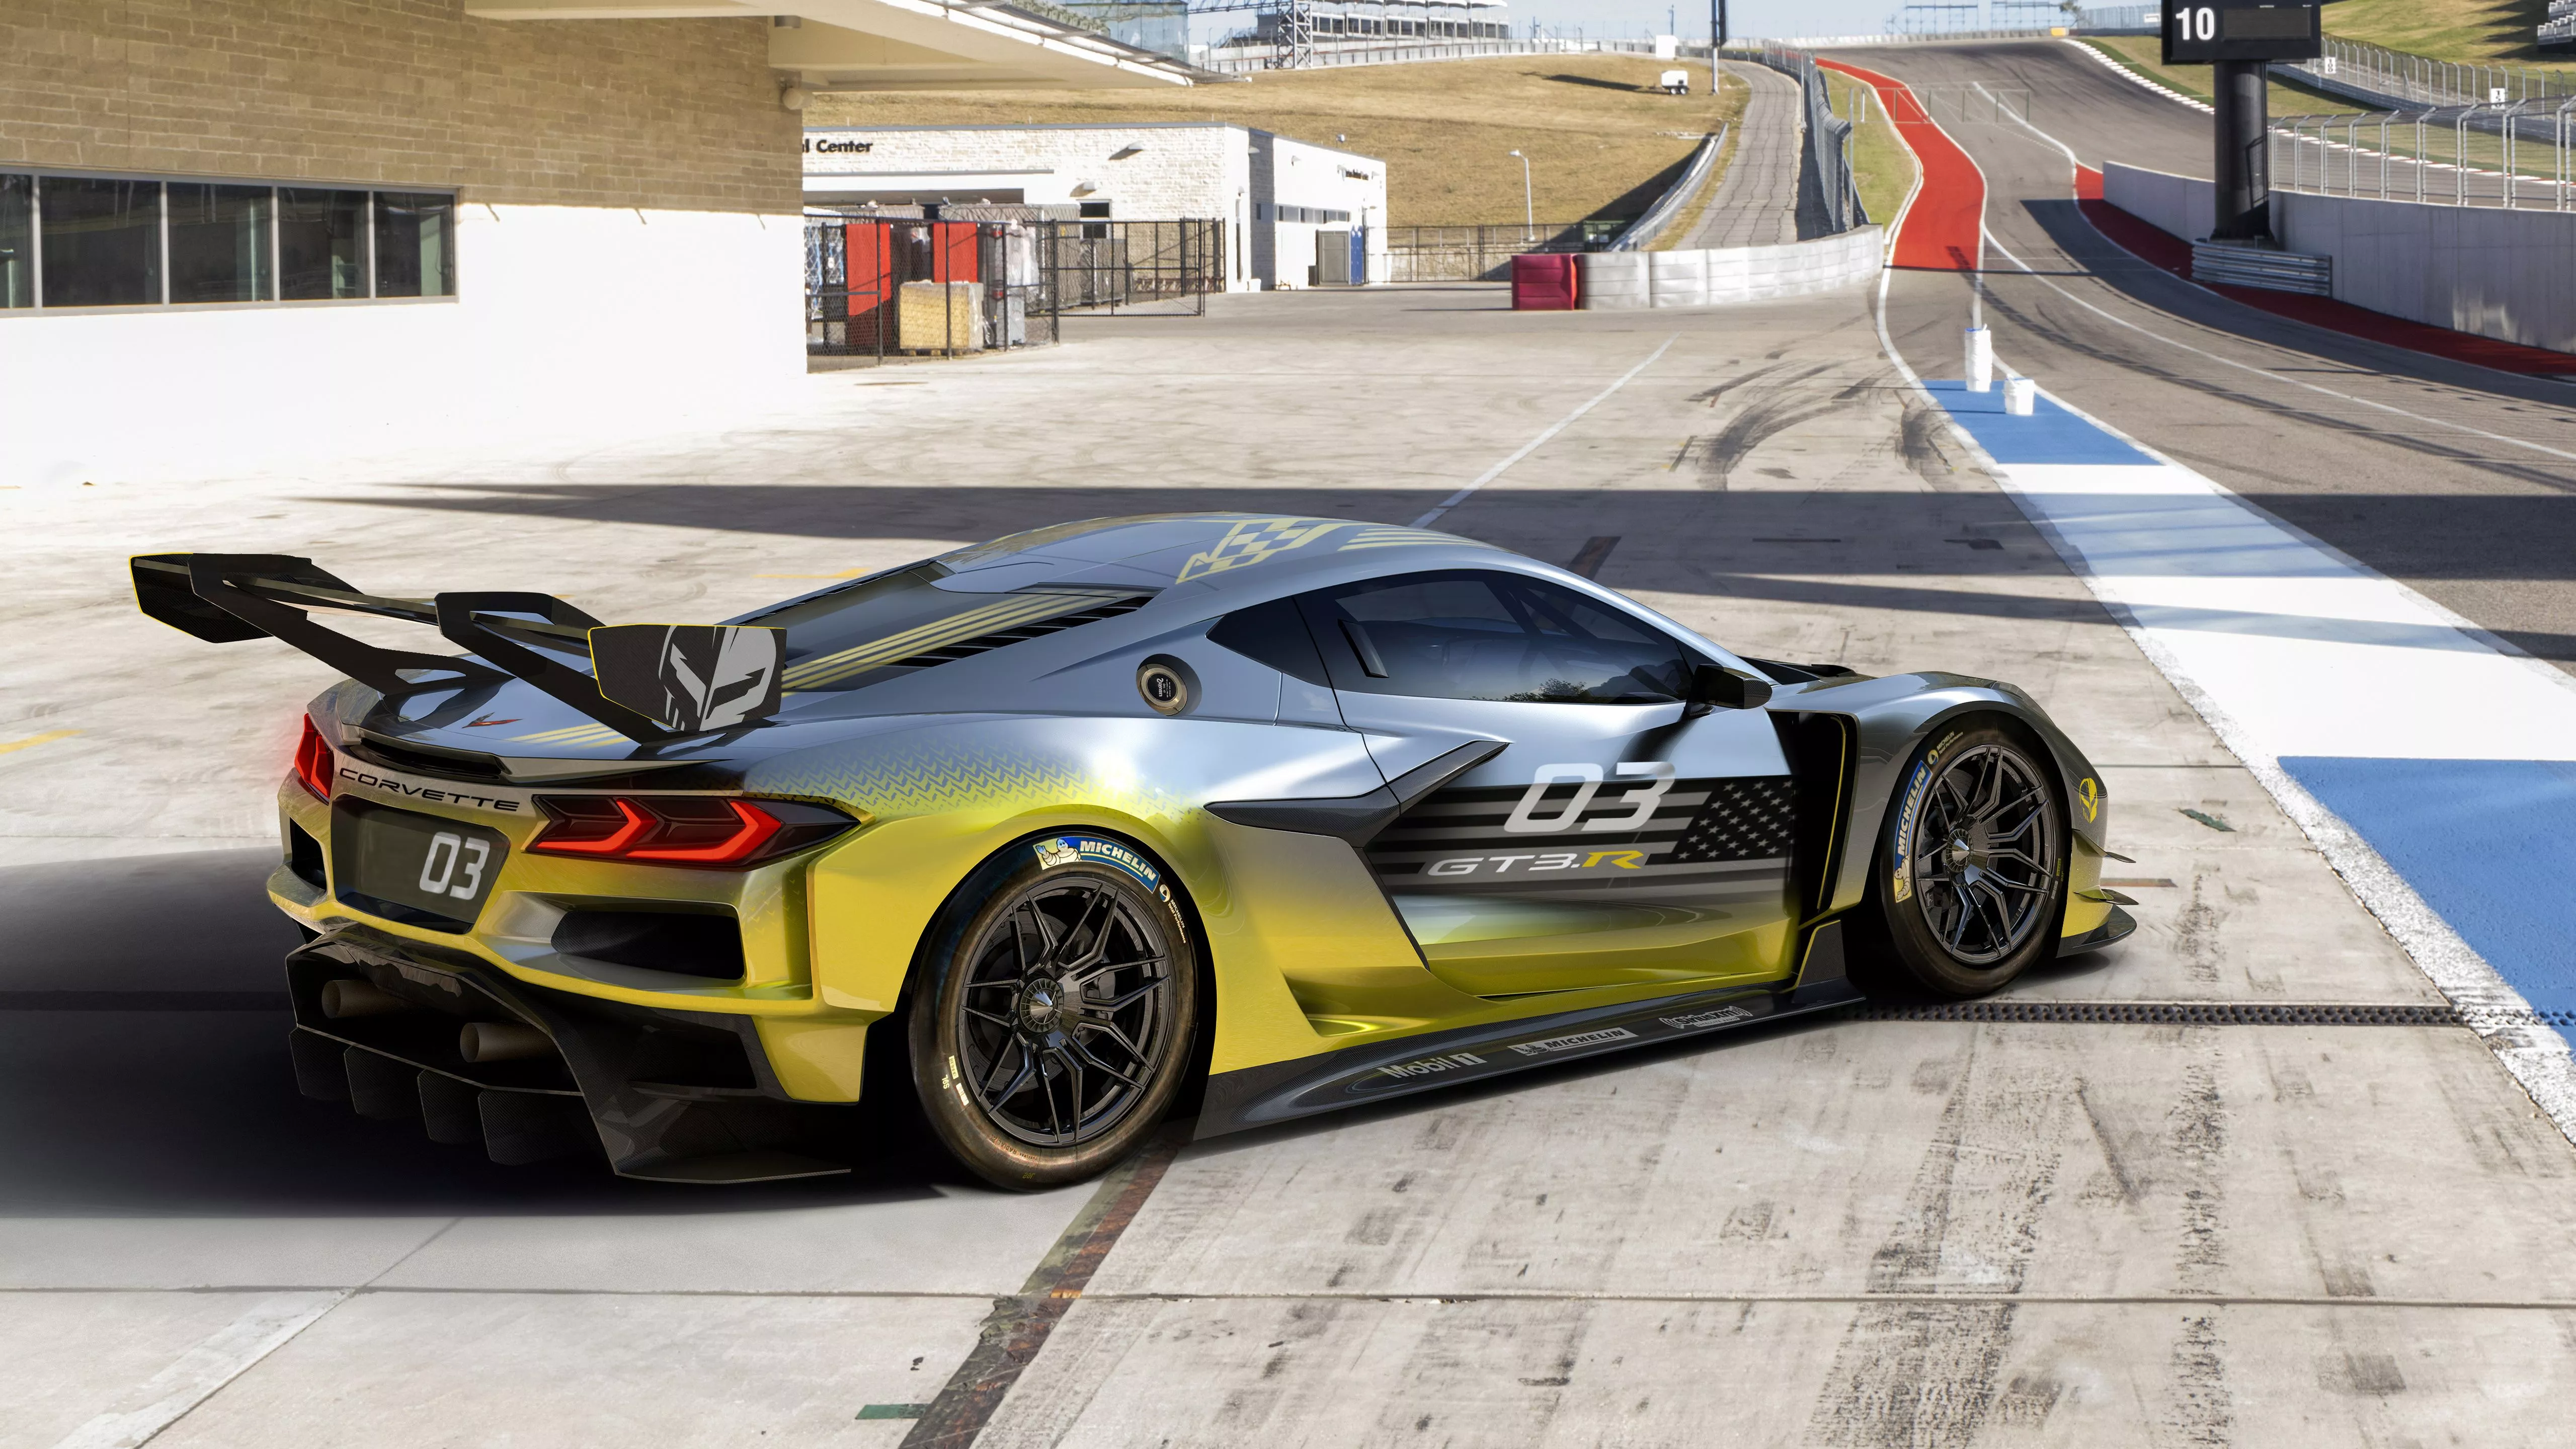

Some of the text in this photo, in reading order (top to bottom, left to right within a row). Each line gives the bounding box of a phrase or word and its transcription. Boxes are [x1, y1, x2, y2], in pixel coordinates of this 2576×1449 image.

[2176, 8, 2215, 40] 10
[816, 139, 873, 153] Center
[1937, 731, 1954, 751] MICHELIN
[340, 768, 520, 812] CORVETTE
[1504, 762, 1676, 833] 03
[1897, 766, 1926, 855] MICHELIN
[419, 832, 490, 900] 03
[1080, 841, 1157, 881] MICHELIN
[1427, 850, 1644, 876] GT3.R
[1170, 899, 1185, 928] MICHELIN
[1173, 913, 1186, 943] Performance
[1544, 1030, 1626, 1048] MICHELIN
[942, 1074, 950, 1089] S9L
[1377, 1057, 1462, 1078] Mobil
